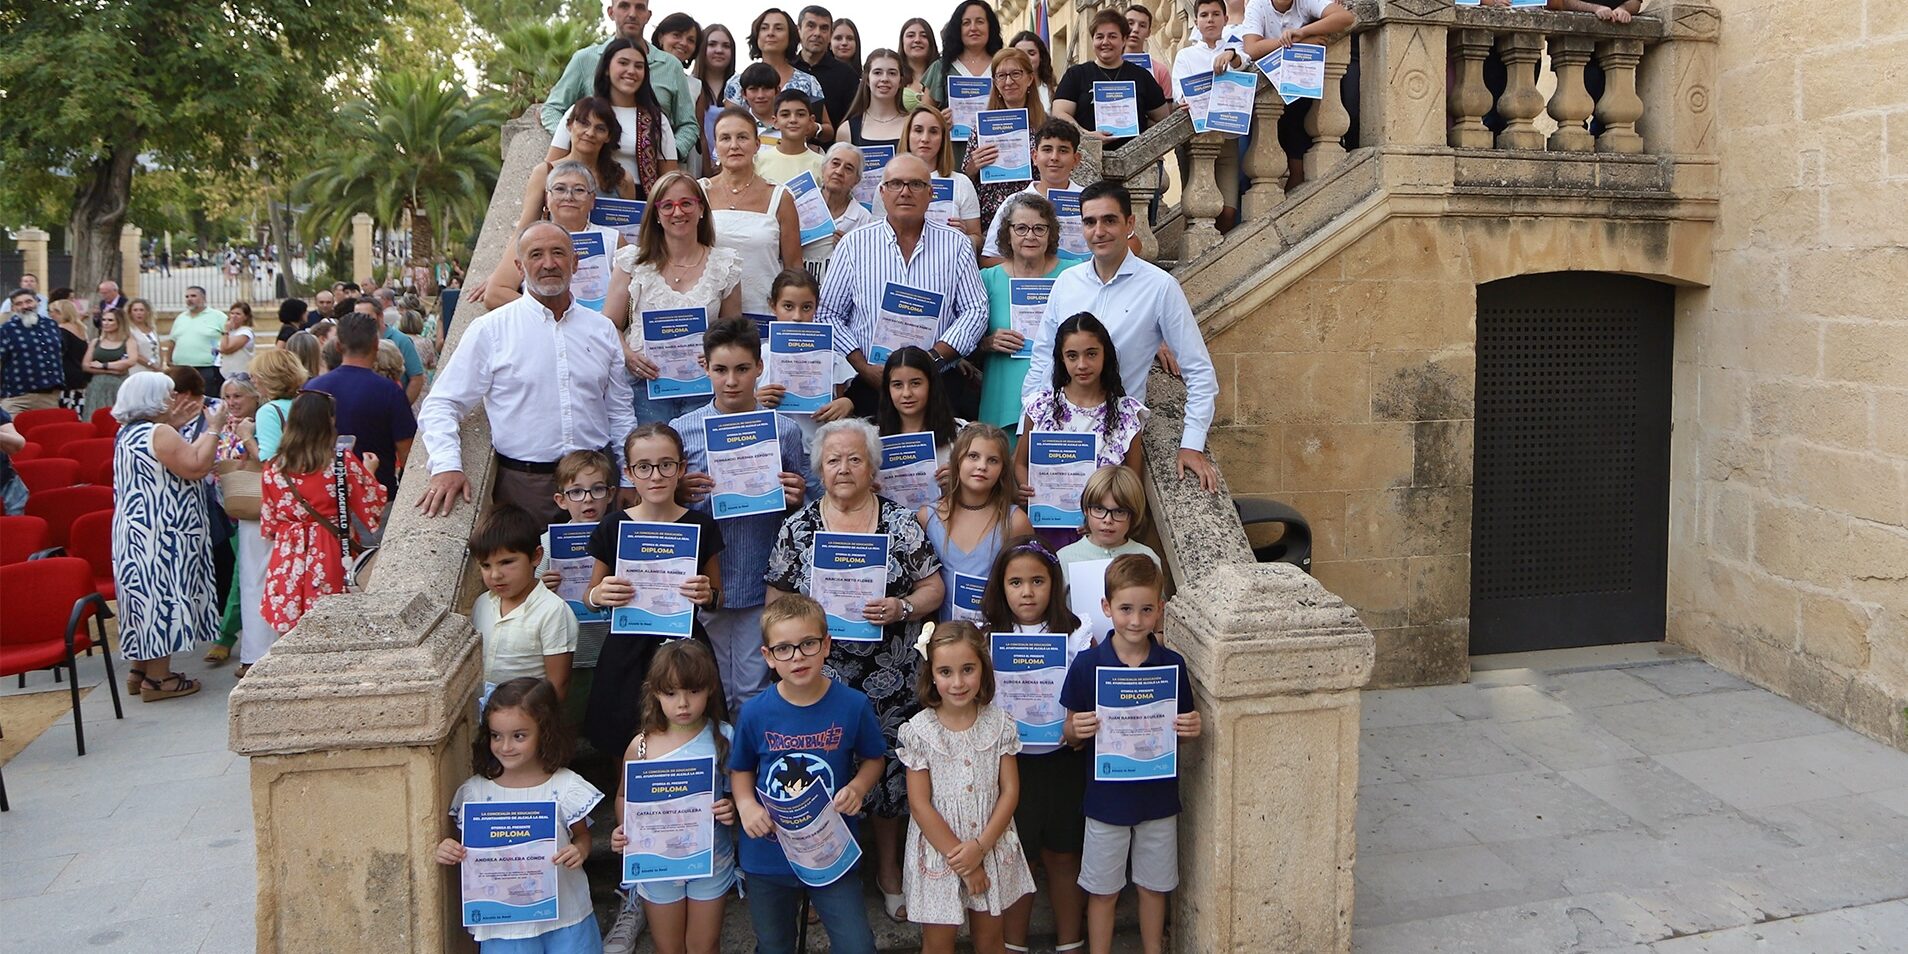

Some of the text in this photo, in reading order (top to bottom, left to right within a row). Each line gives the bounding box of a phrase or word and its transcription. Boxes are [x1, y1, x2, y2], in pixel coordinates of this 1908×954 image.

[726, 435, 757, 443] DIPLOMA
[766, 732, 805, 750] DRAGON
[651, 785, 688, 794] DIPLOMA
[490, 830, 531, 838] DIPLOMA
